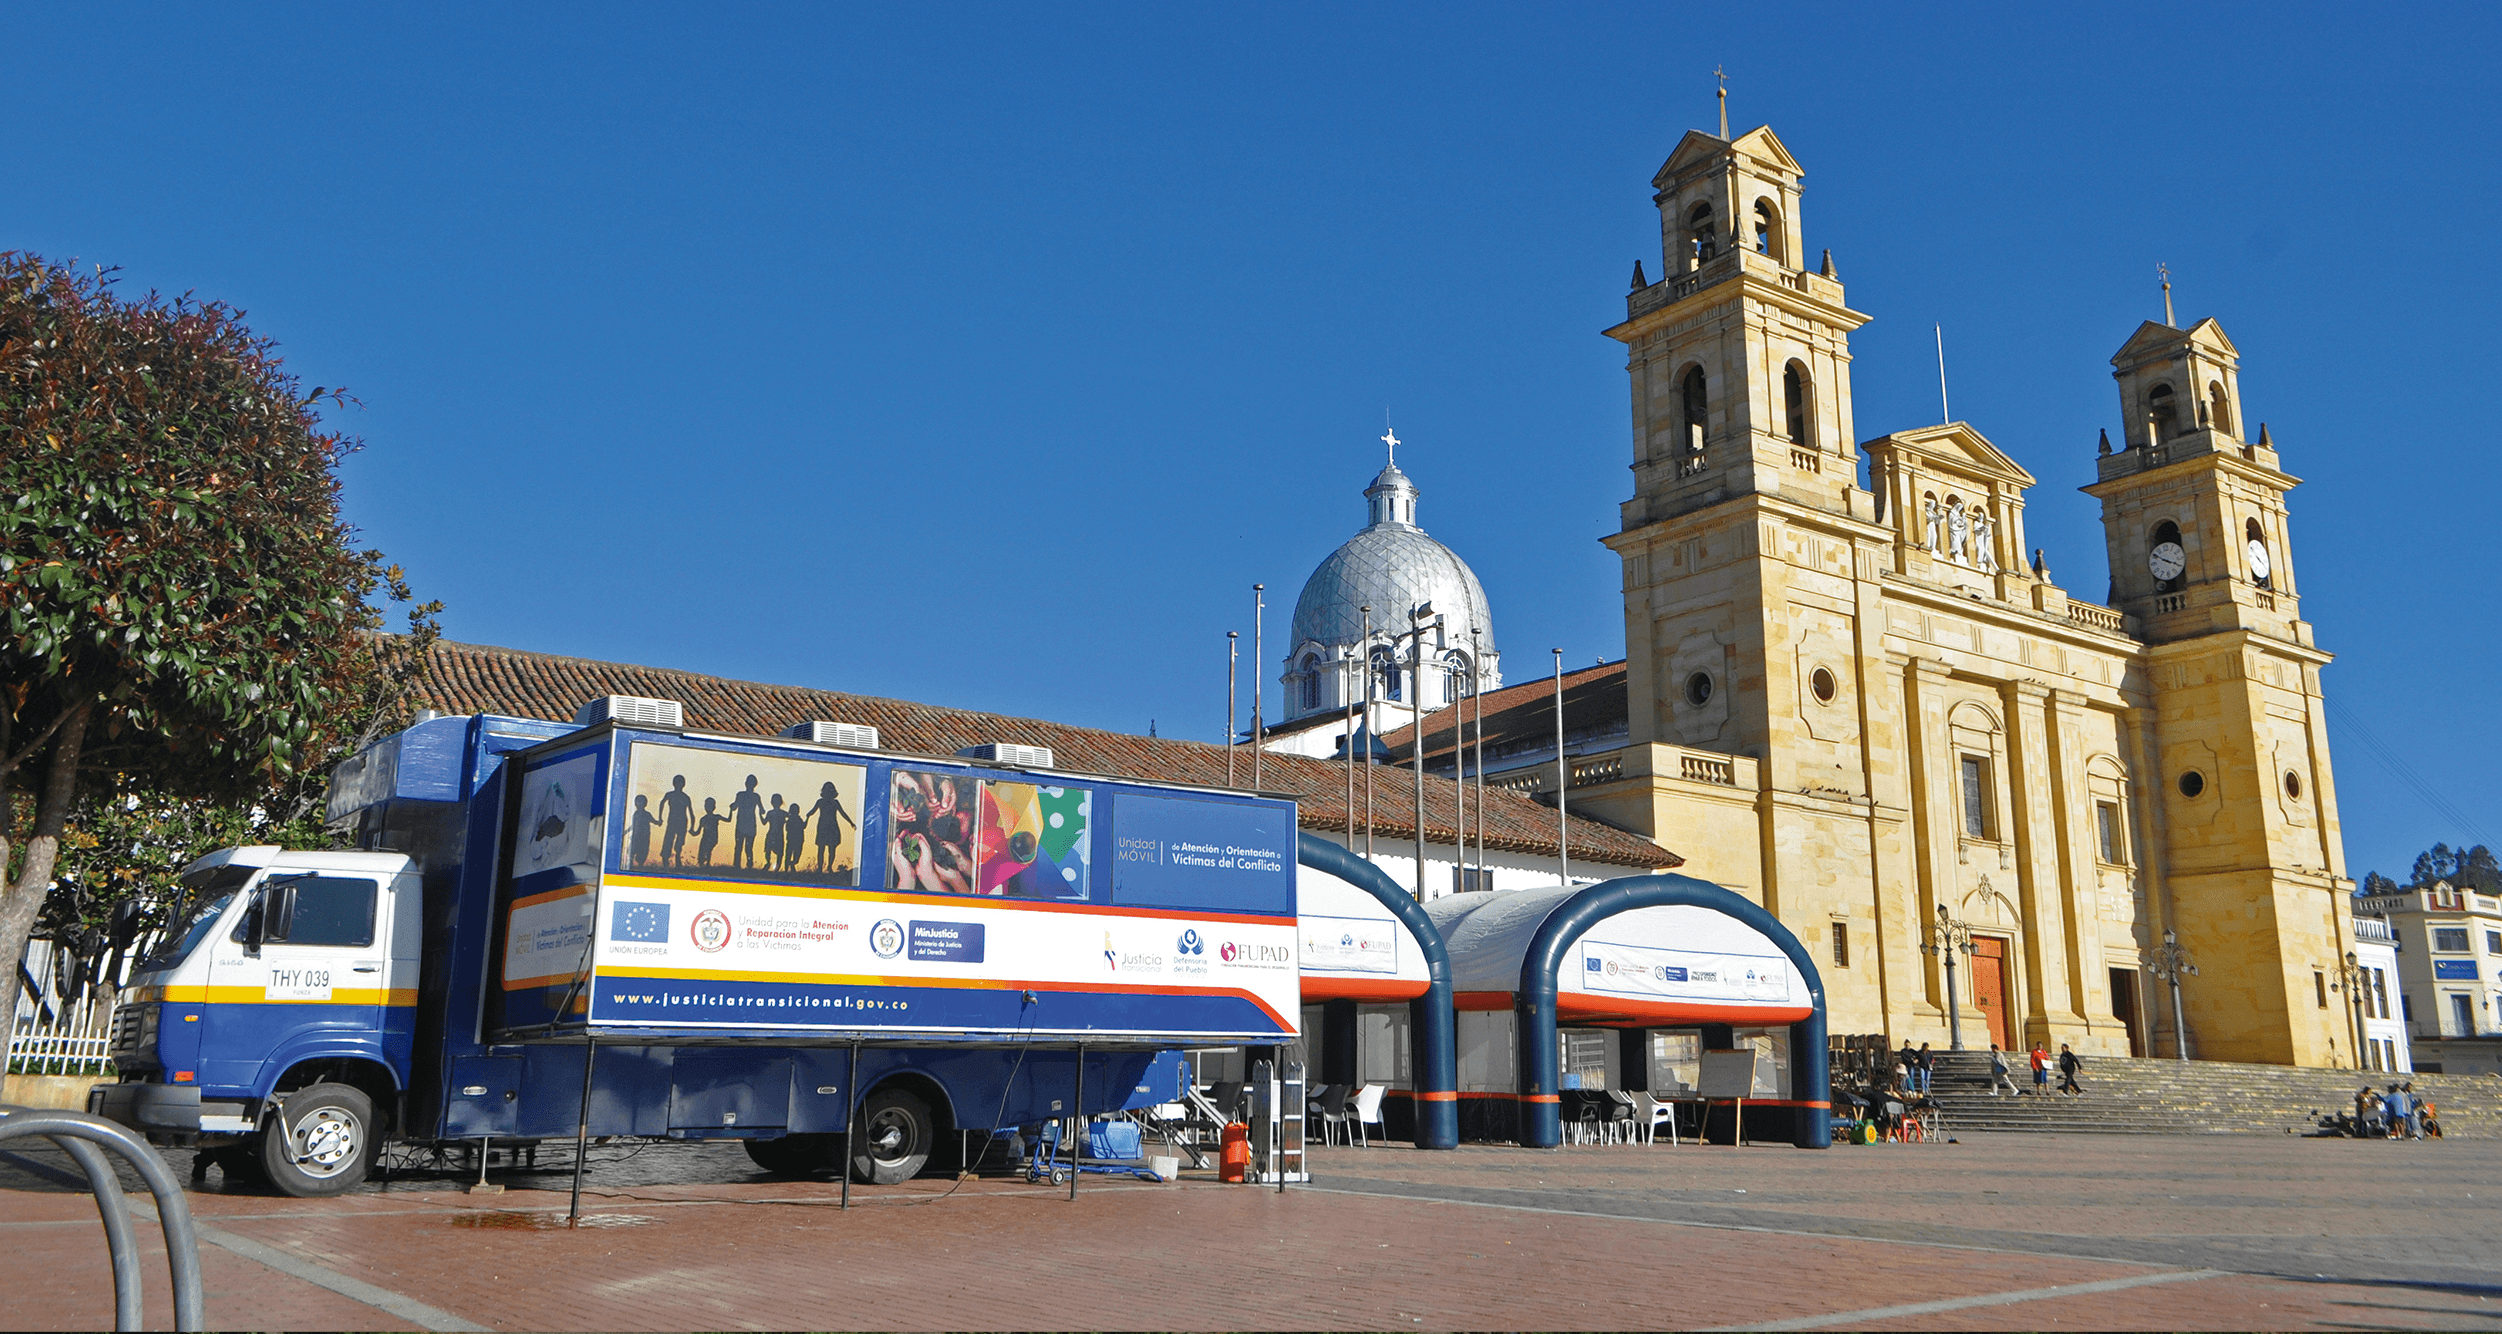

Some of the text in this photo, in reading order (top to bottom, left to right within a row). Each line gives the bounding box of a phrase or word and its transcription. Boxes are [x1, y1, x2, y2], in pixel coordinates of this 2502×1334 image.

[1118, 837, 1156, 849] Unidad
[1181, 842, 1220, 854] Atención
[1226, 845, 1276, 859] Orientación
[1118, 848, 1156, 863] MÓVIL
[1172, 853, 1281, 872] Víctimas del Conflicto
[738, 915, 849, 930] Unidad para la Atención
[737, 927, 833, 942] y Reparación Integral
[914, 927, 959, 939] MinJusticia
[609, 945, 668, 956] UNIÓN EUROPEA
[747, 938, 760, 949] las
[1121, 953, 1162, 966] Justicia
[1238, 944, 1289, 963] FUPAD
[1121, 964, 1162, 973] Transicional
[1186, 966, 1208, 974] Pueblo
[272, 969, 330, 987] THY 039
[613, 992, 908, 1010] www.justiciatransicional.gov.co
